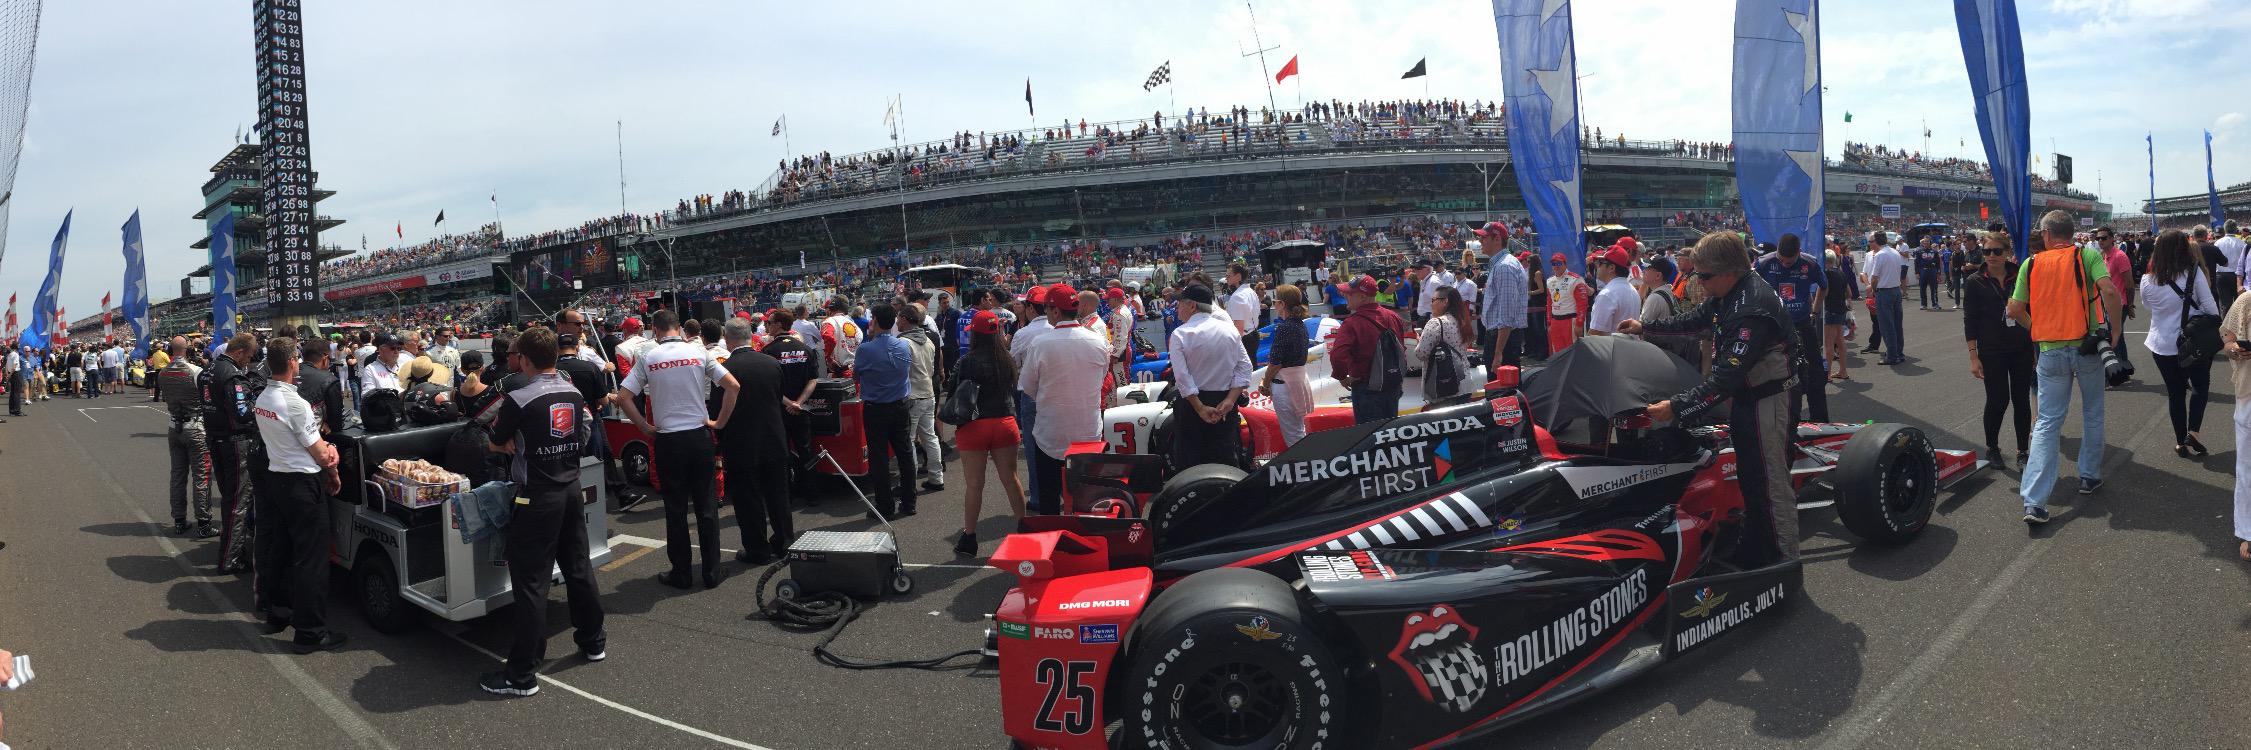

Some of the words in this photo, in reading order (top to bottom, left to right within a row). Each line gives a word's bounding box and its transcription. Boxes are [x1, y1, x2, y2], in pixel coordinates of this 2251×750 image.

[287, 11, 298, 20] 20
[288, 25, 299, 34] 32
[290, 39, 300, 48] 83
[294, 53, 299, 61] 2
[291, 66, 301, 75] 28
[292, 80, 302, 89] 15
[293, 93, 303, 102] 29
[295, 107, 301, 116] 7
[293, 120, 304, 130] 48
[297, 134, 303, 142] 8
[296, 147, 306, 156] 43
[296, 160, 307, 169] 24
[297, 173, 307, 182] 14
[297, 186, 308, 196] 63
[298, 200, 308, 209] 98
[299, 213, 308, 221] 17
[299, 226, 309, 235] 41
[302, 239, 309, 248] 4
[301, 251, 312, 261] 88
[304, 265, 310, 274] 5
[302, 278, 313, 287] 18
[303, 291, 313, 300] 19
[648, 359, 700, 372] HONDA
[1136, 370, 1154, 382] 10
[256, 408, 279, 421] ONDA
[1372, 415, 1485, 445] HONDA
[1114, 422, 1137, 454] 3
[1507, 438, 1527, 446] JUSTIN
[536, 443, 579, 454] ANDRETT
[1502, 444, 1528, 453] WILSON
[1269, 441, 1428, 487] MERCHANT
[1359, 466, 1432, 499] FIRST
[1581, 474, 1638, 498] MERCHANT
[1645, 464, 1668, 479] FIRST
[1634, 504, 1673, 530] Firestone
[353, 521, 399, 548] HONDA
[1059, 601, 1091, 610] DMG
[1093, 599, 1130, 608] MORI
[1676, 601, 1754, 652] INDIANAPOLIS,
[1755, 590, 1778, 616] JULY
[1778, 582, 1785, 600] 4
[1494, 646, 1503, 687] THE
[1502, 607, 1587, 685] ROLLING
[1589, 568, 1647, 637] STONES
[1034, 626, 1075, 640] FARO
[1034, 657, 1097, 735] 25
[1288, 681, 1302, 719] RACING
[1300, 654, 1331, 750] Firesto
